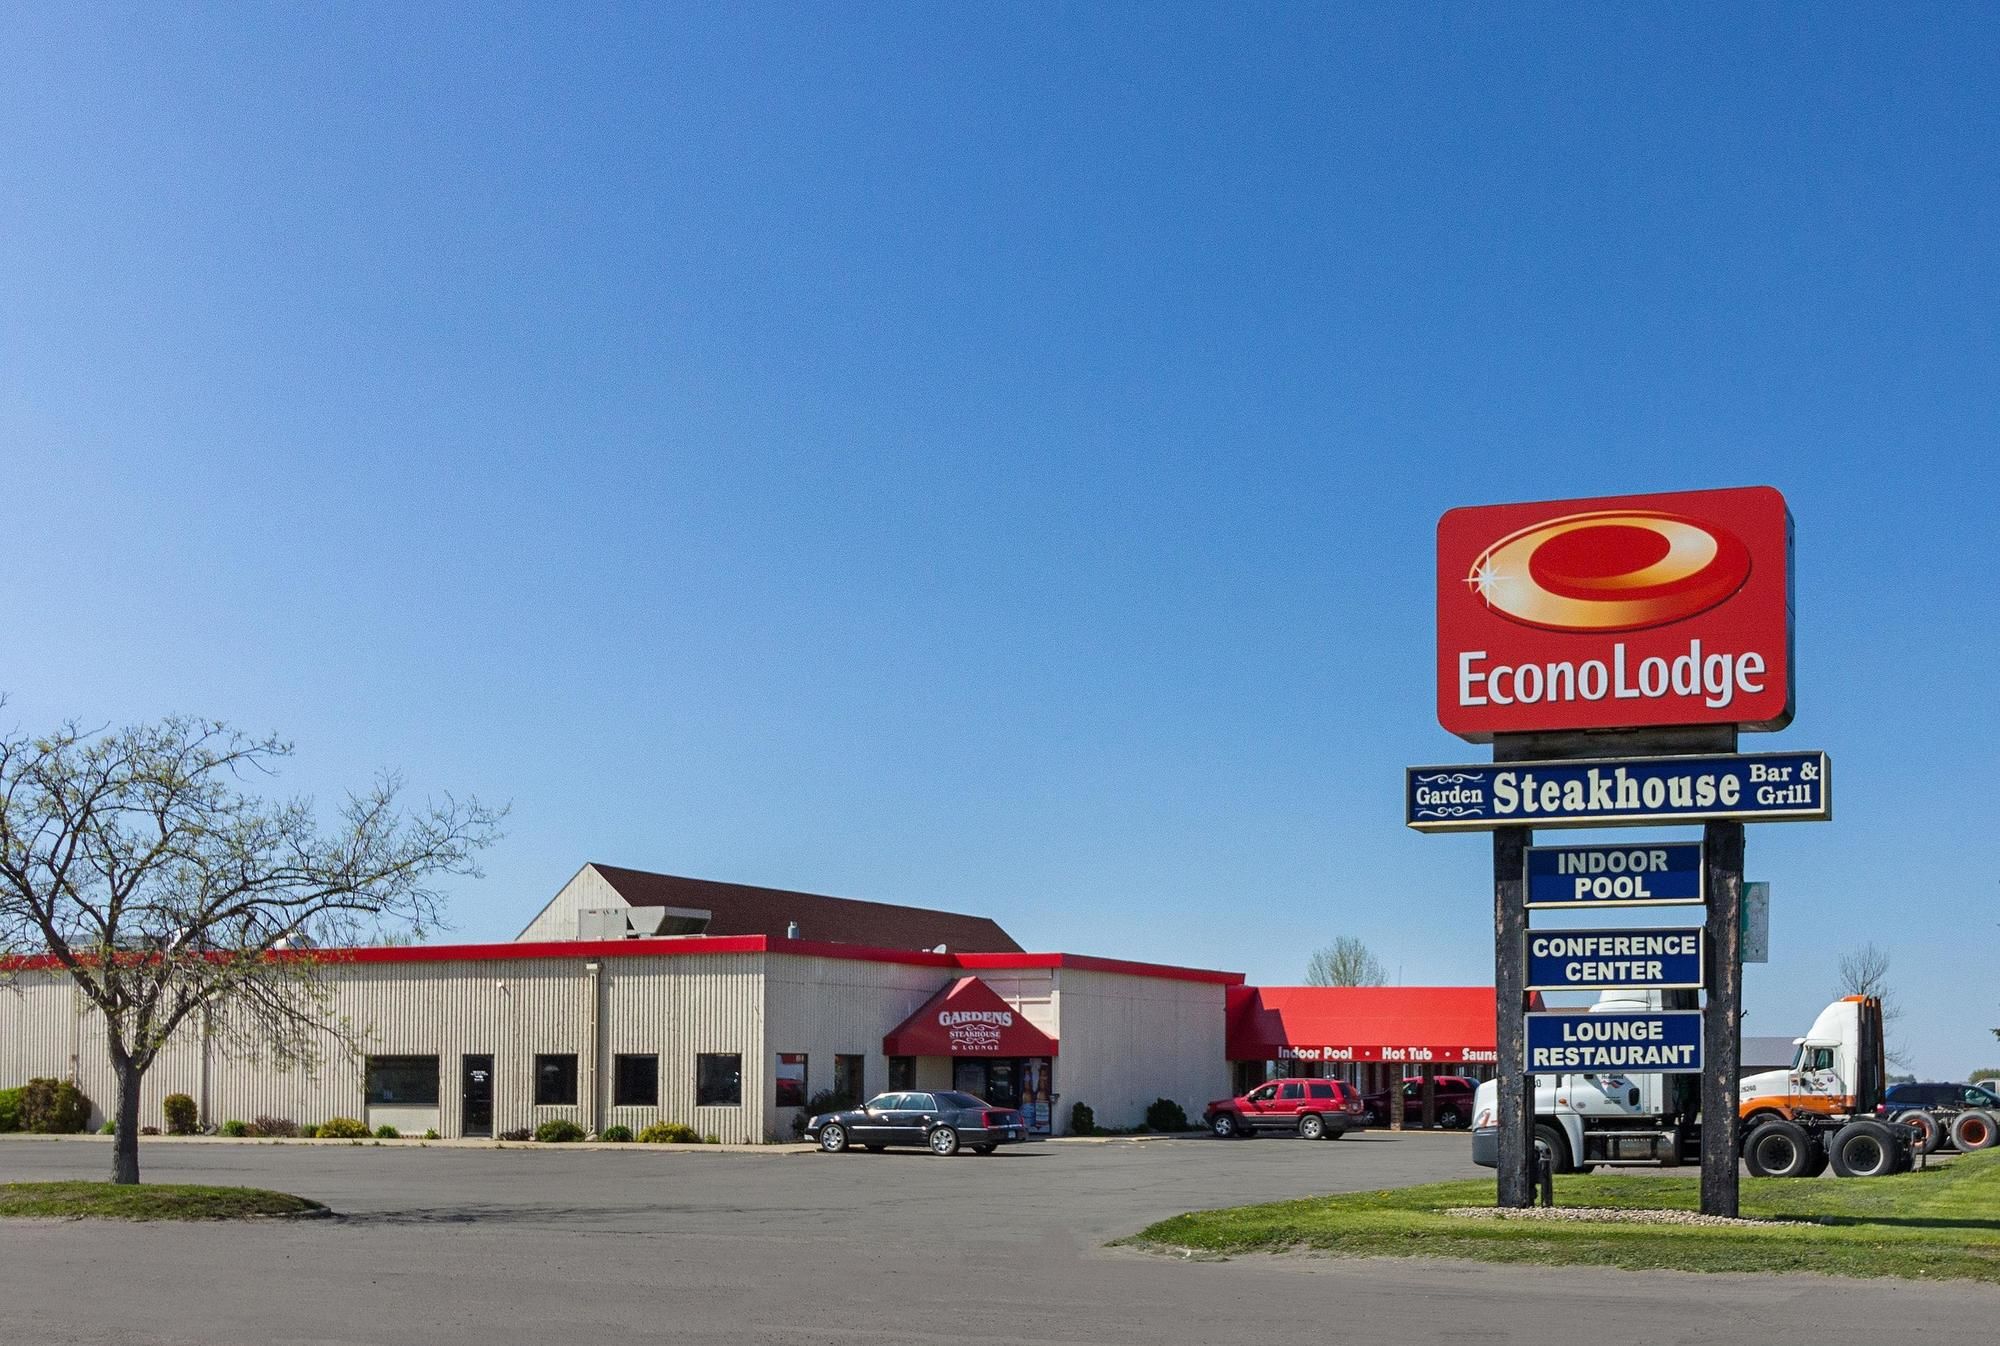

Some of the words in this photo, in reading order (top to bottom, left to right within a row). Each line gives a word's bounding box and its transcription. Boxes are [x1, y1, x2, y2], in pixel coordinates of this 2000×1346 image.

[1749, 763, 1793, 783] Bar
[1800, 761, 1819, 780] &
[1416, 785, 1484, 805] Garden
[1493, 768, 1741, 814] Steakhouse
[1756, 784, 1812, 805] Grill
[1558, 850, 1668, 874] INDOOR
[1575, 876, 1651, 899] POOL
[1532, 936, 1697, 958] CONFERENCE
[1565, 961, 1663, 981] CENTER
[938, 1010, 1013, 1027] GARDENS
[949, 1031, 1001, 1039] STEAKHOUSE
[1563, 1021, 1664, 1042] LOUNGE
[1278, 1046, 1320, 1059] Indoor
[1323, 1046, 1353, 1059] Pool
[1382, 1046, 1406, 1060] Hot
[1408, 1047, 1433, 1060] Tub
[1533, 1045, 1695, 1066] RESTAURANT
